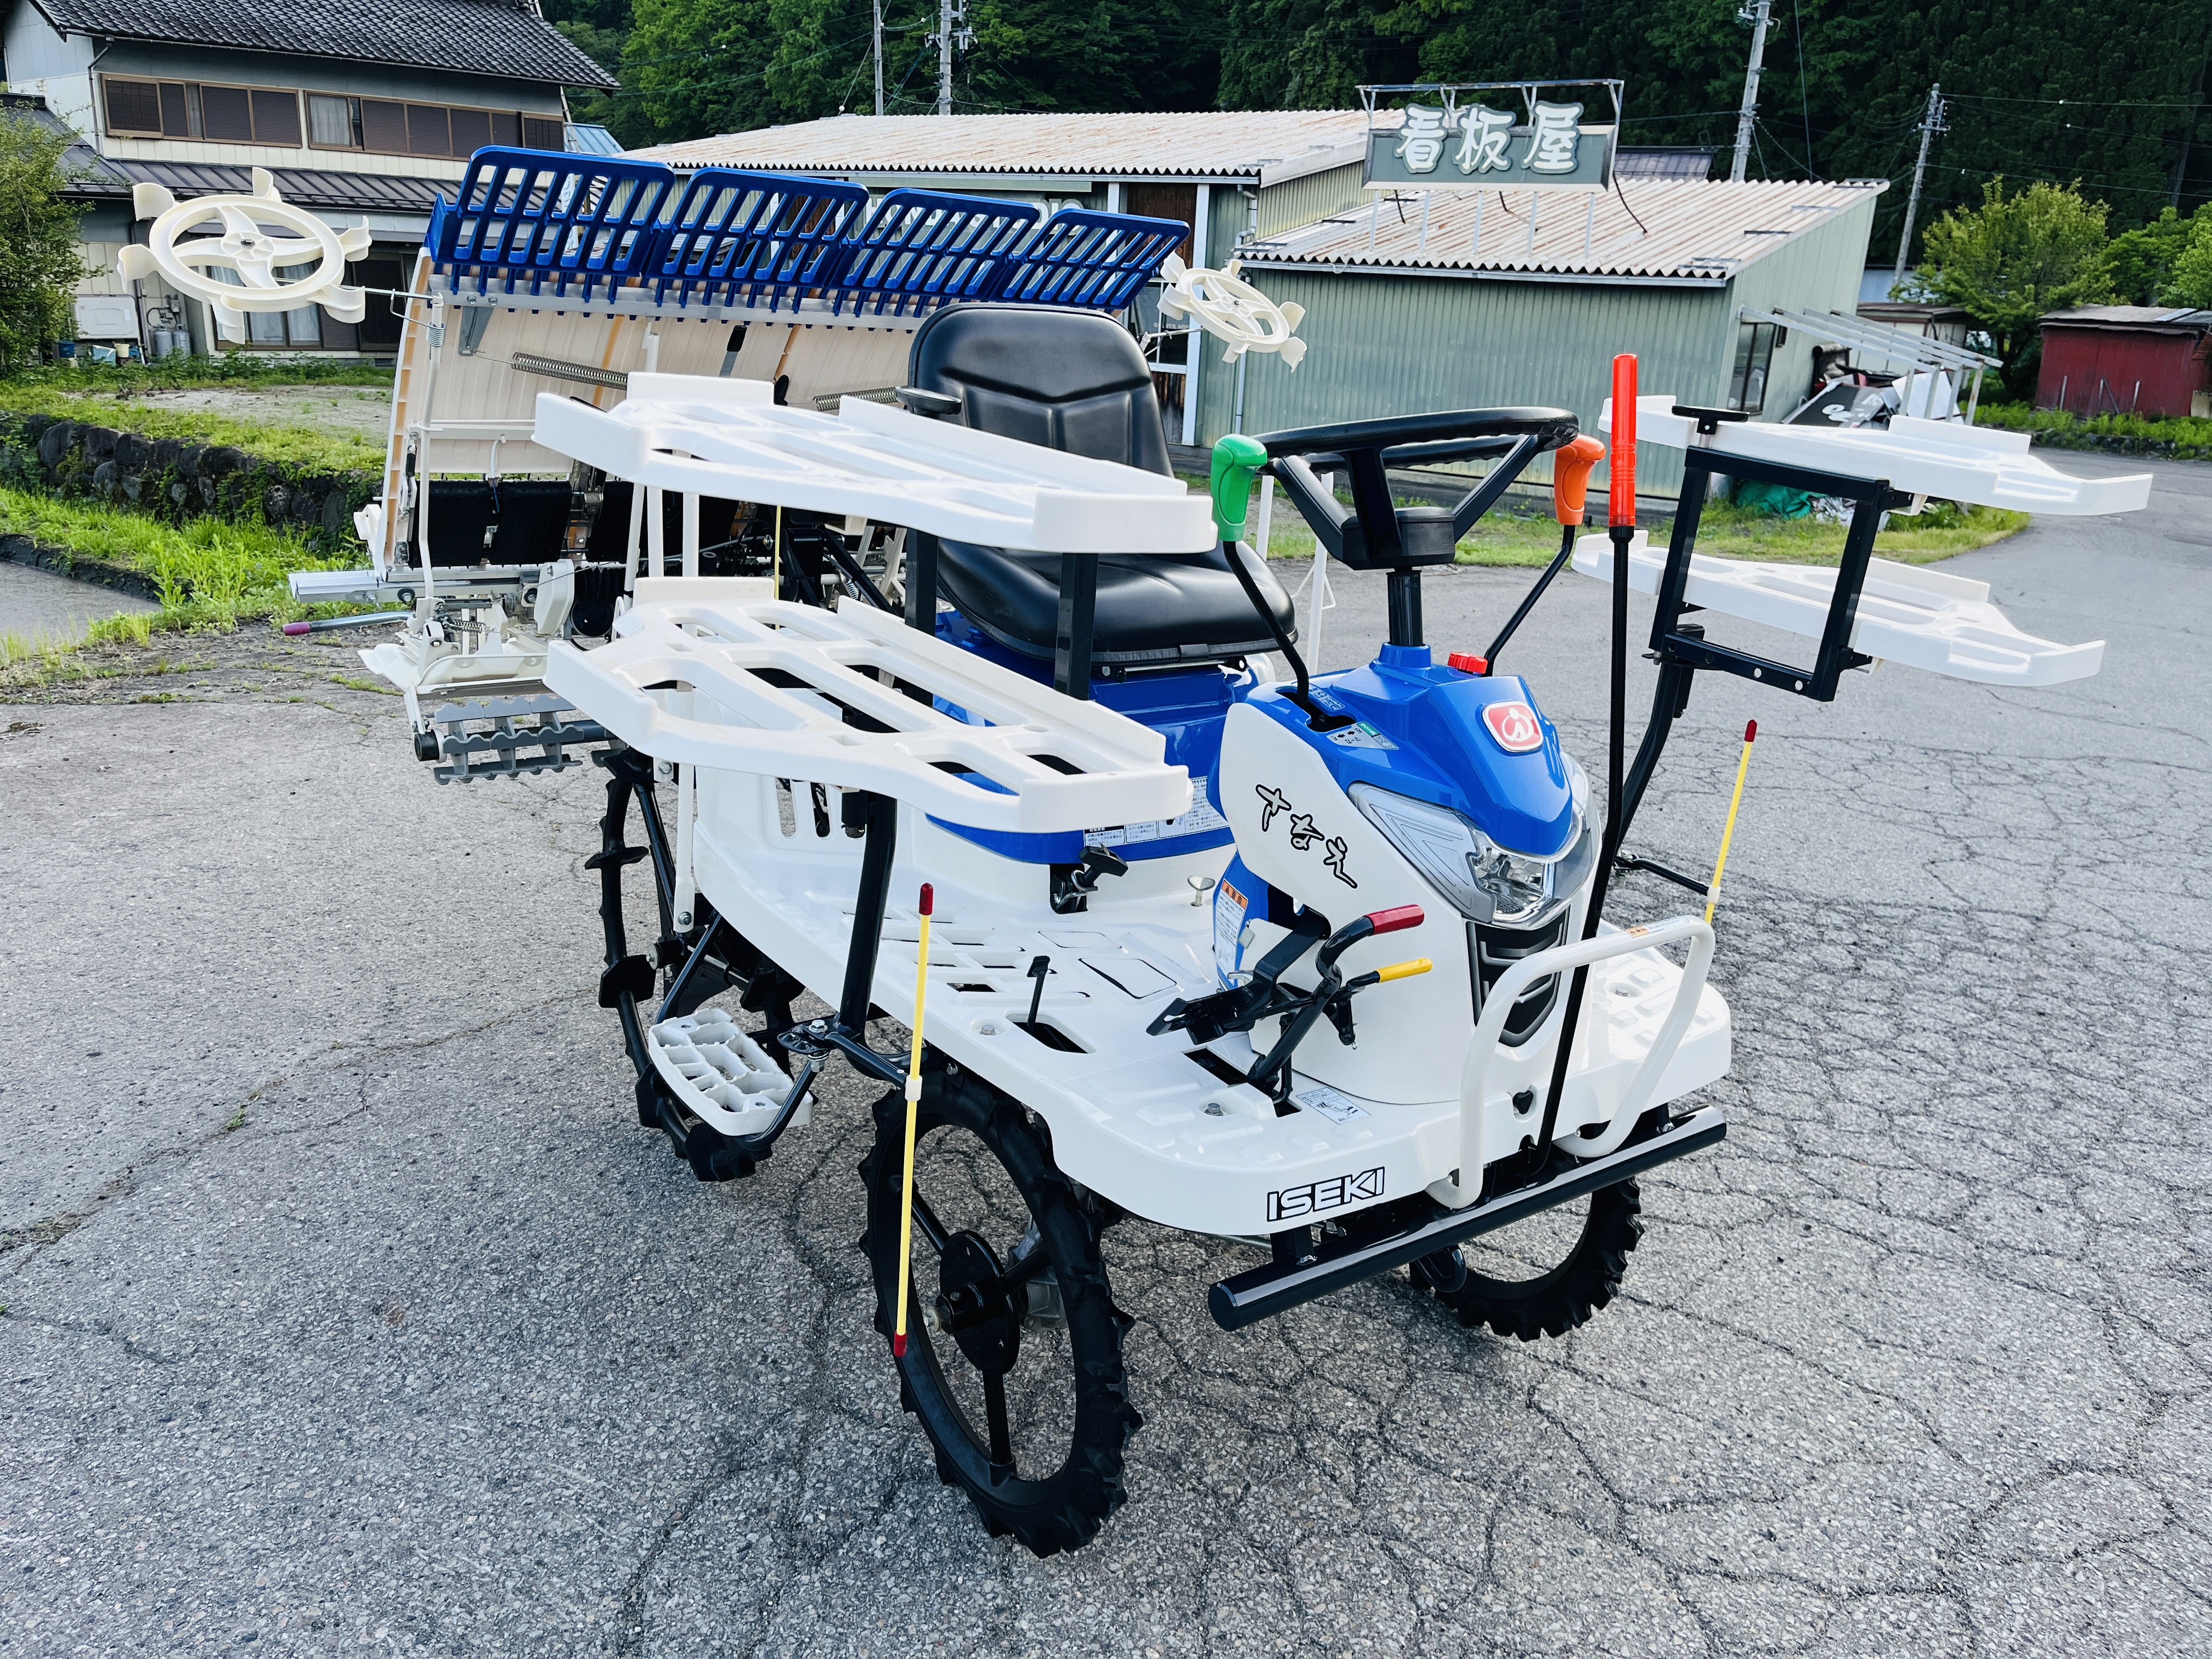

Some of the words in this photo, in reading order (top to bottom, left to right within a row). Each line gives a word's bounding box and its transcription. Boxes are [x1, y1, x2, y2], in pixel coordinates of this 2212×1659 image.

[1395, 104, 1583, 173] 看板屋
[1267, 1166, 1385, 1222] ISEKI
